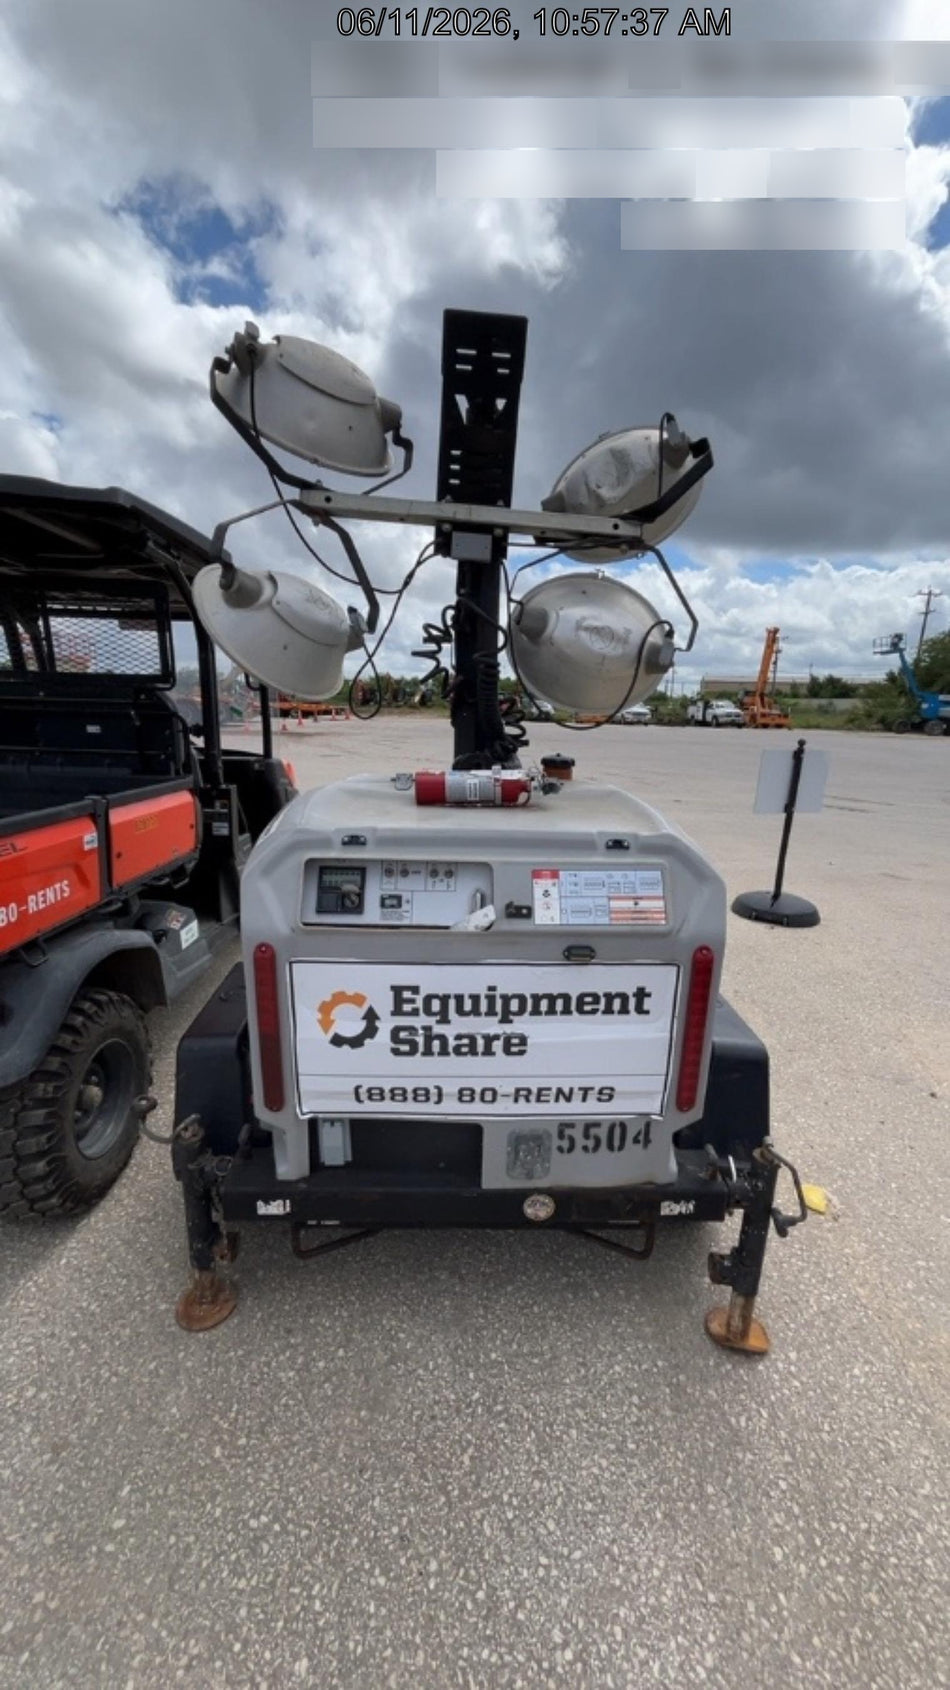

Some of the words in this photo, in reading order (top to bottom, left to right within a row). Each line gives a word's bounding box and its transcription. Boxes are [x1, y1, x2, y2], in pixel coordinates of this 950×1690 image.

[390, 985, 652, 1024] Equipment
[390, 1025, 529, 1057] Share
[353, 1085, 443, 1105] (888)
[457, 1086, 616, 1104] 80-RENTS
[556, 1121, 652, 1154] 5504
